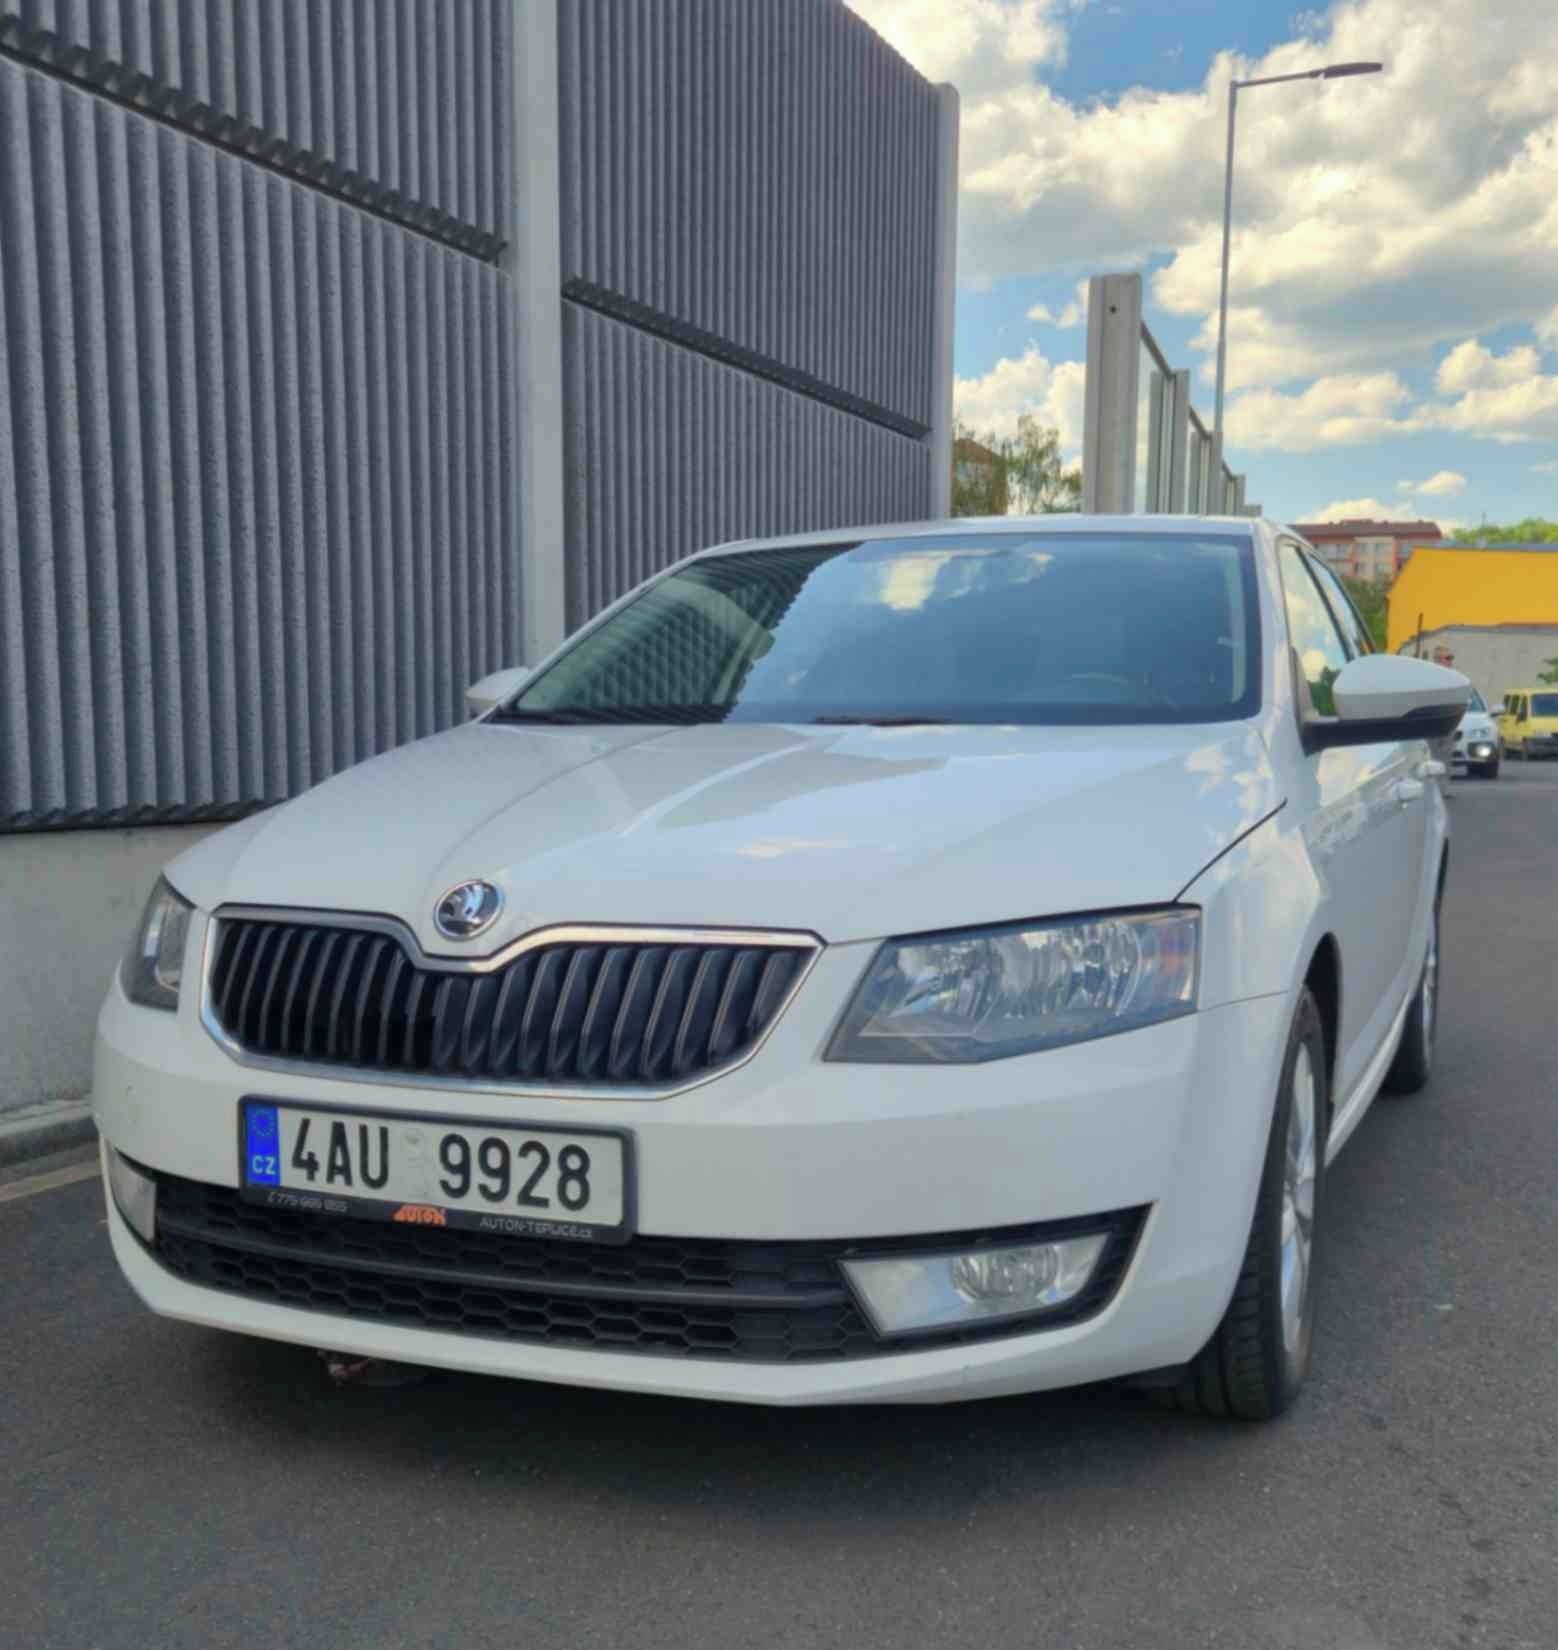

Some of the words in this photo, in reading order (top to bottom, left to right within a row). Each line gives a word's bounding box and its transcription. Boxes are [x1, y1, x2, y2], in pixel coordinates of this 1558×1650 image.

[252, 1155, 277, 1175] CZ
[291, 1118, 389, 1190] 4AU
[439, 1132, 591, 1212] 9928
